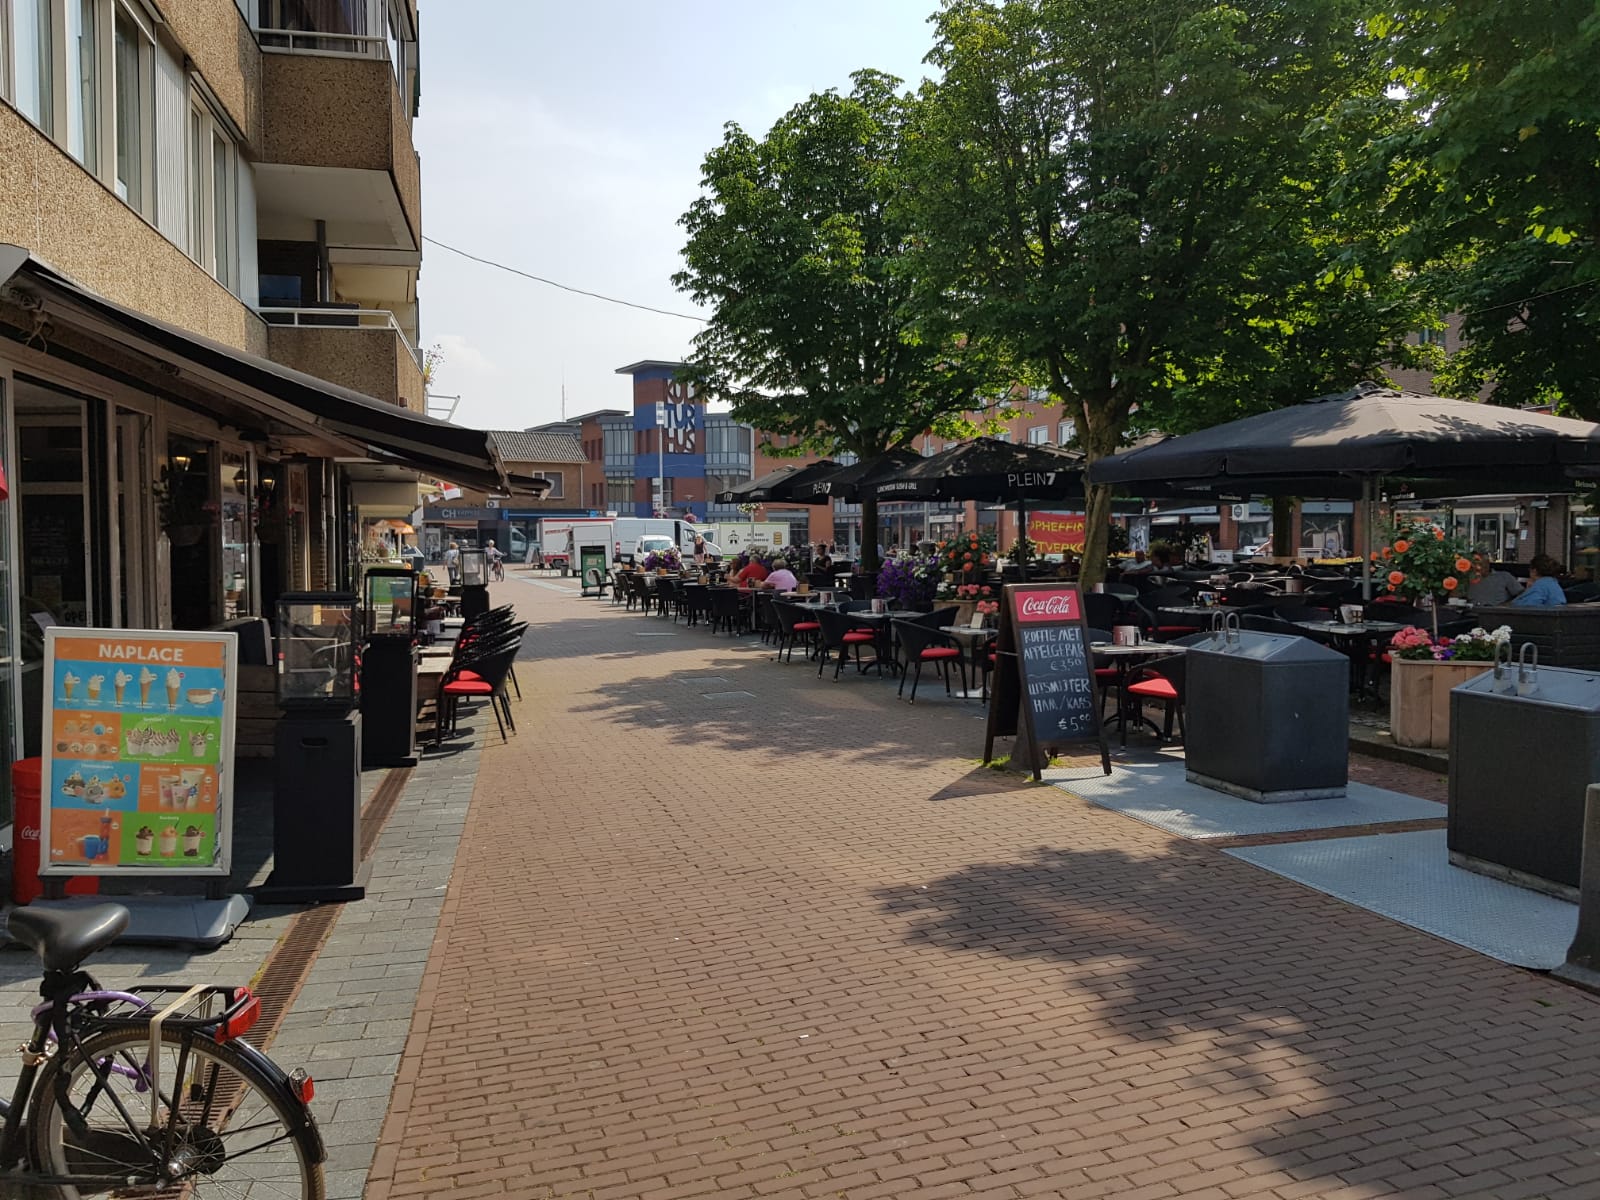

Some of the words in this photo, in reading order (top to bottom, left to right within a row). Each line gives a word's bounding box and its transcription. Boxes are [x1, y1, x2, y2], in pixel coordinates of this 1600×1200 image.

[664, 403, 695, 429] TUR
[664, 427, 695, 454] HUS
[1007, 472, 1056, 487] PLEIN7
[441, 508, 456, 519] CH
[1022, 595, 1071, 615] Coca-Cola
[1023, 629, 1057, 643] KOFFIE
[1058, 627, 1080, 641] MET
[98, 644, 184, 662] NAPLACE
